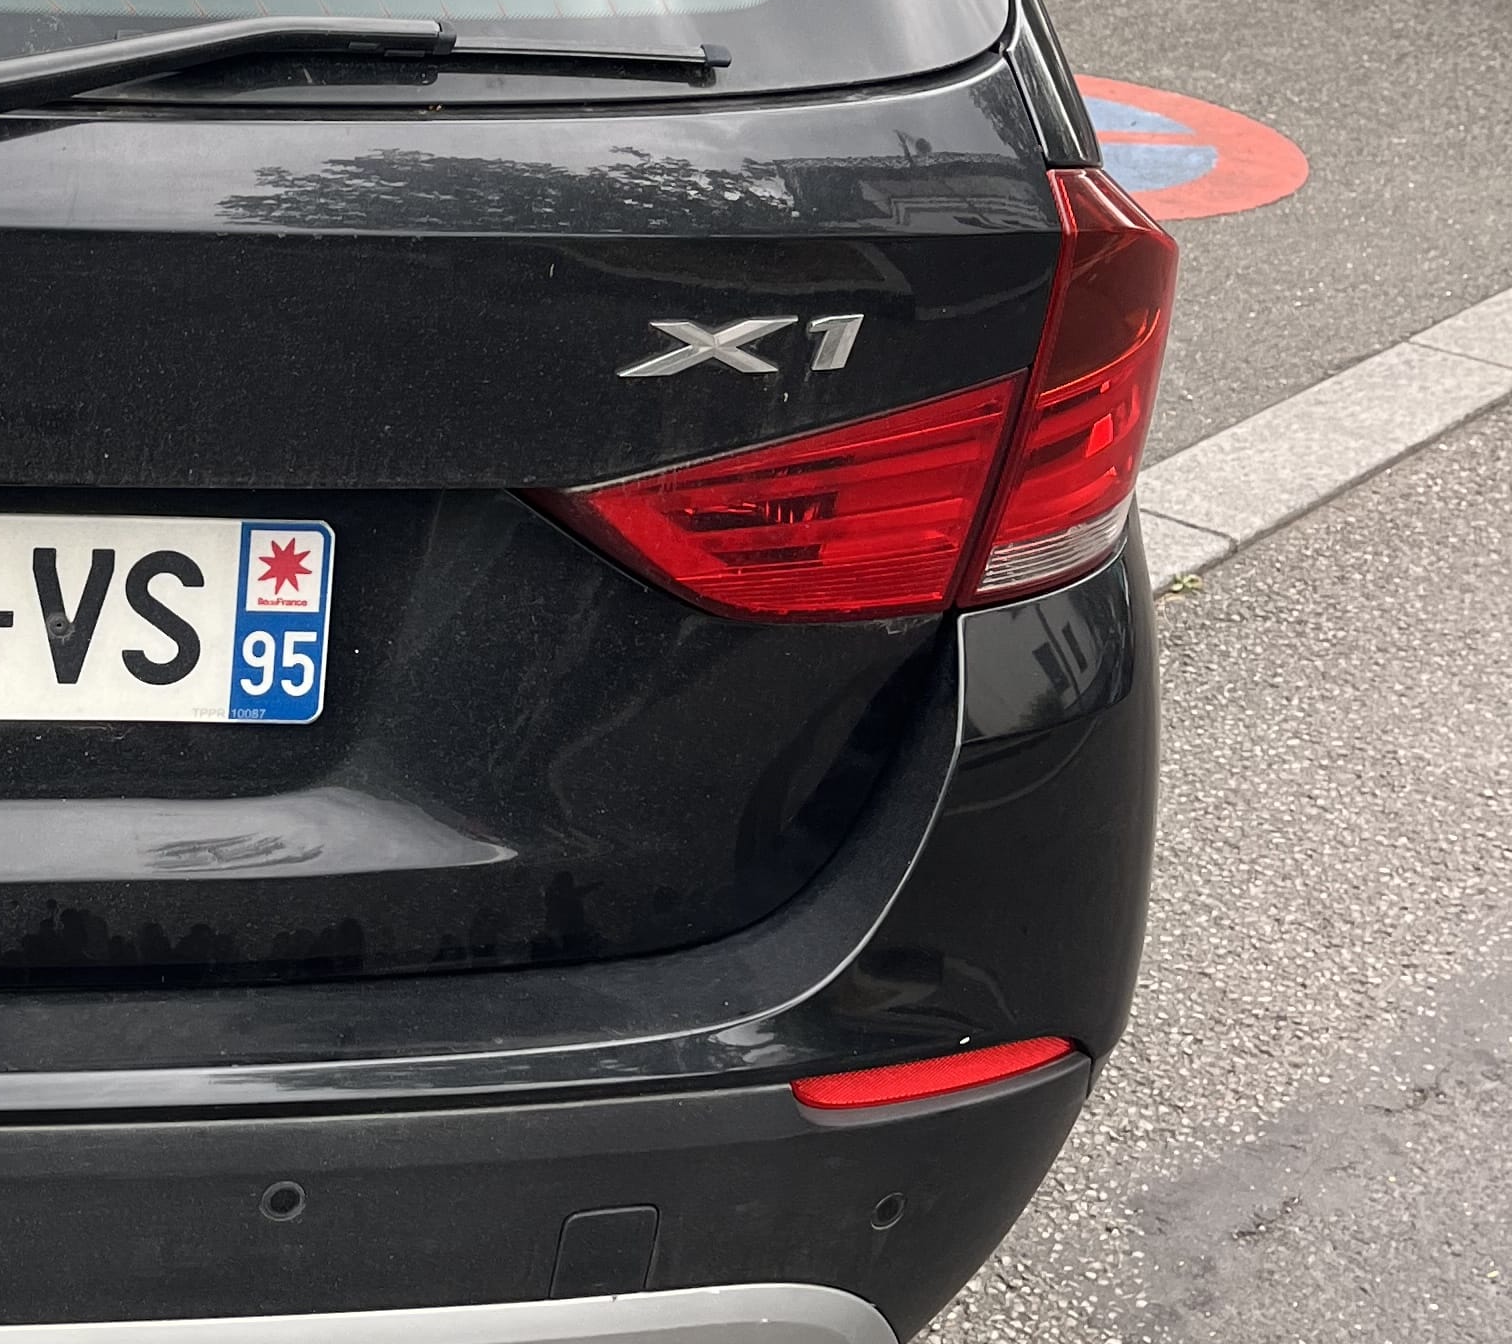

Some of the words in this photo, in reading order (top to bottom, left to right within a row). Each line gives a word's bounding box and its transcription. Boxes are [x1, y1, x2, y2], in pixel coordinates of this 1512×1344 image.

[617, 314, 865, 376] X1
[240, 630, 318, 697] 95
[231, 708, 266, 720] 10087
